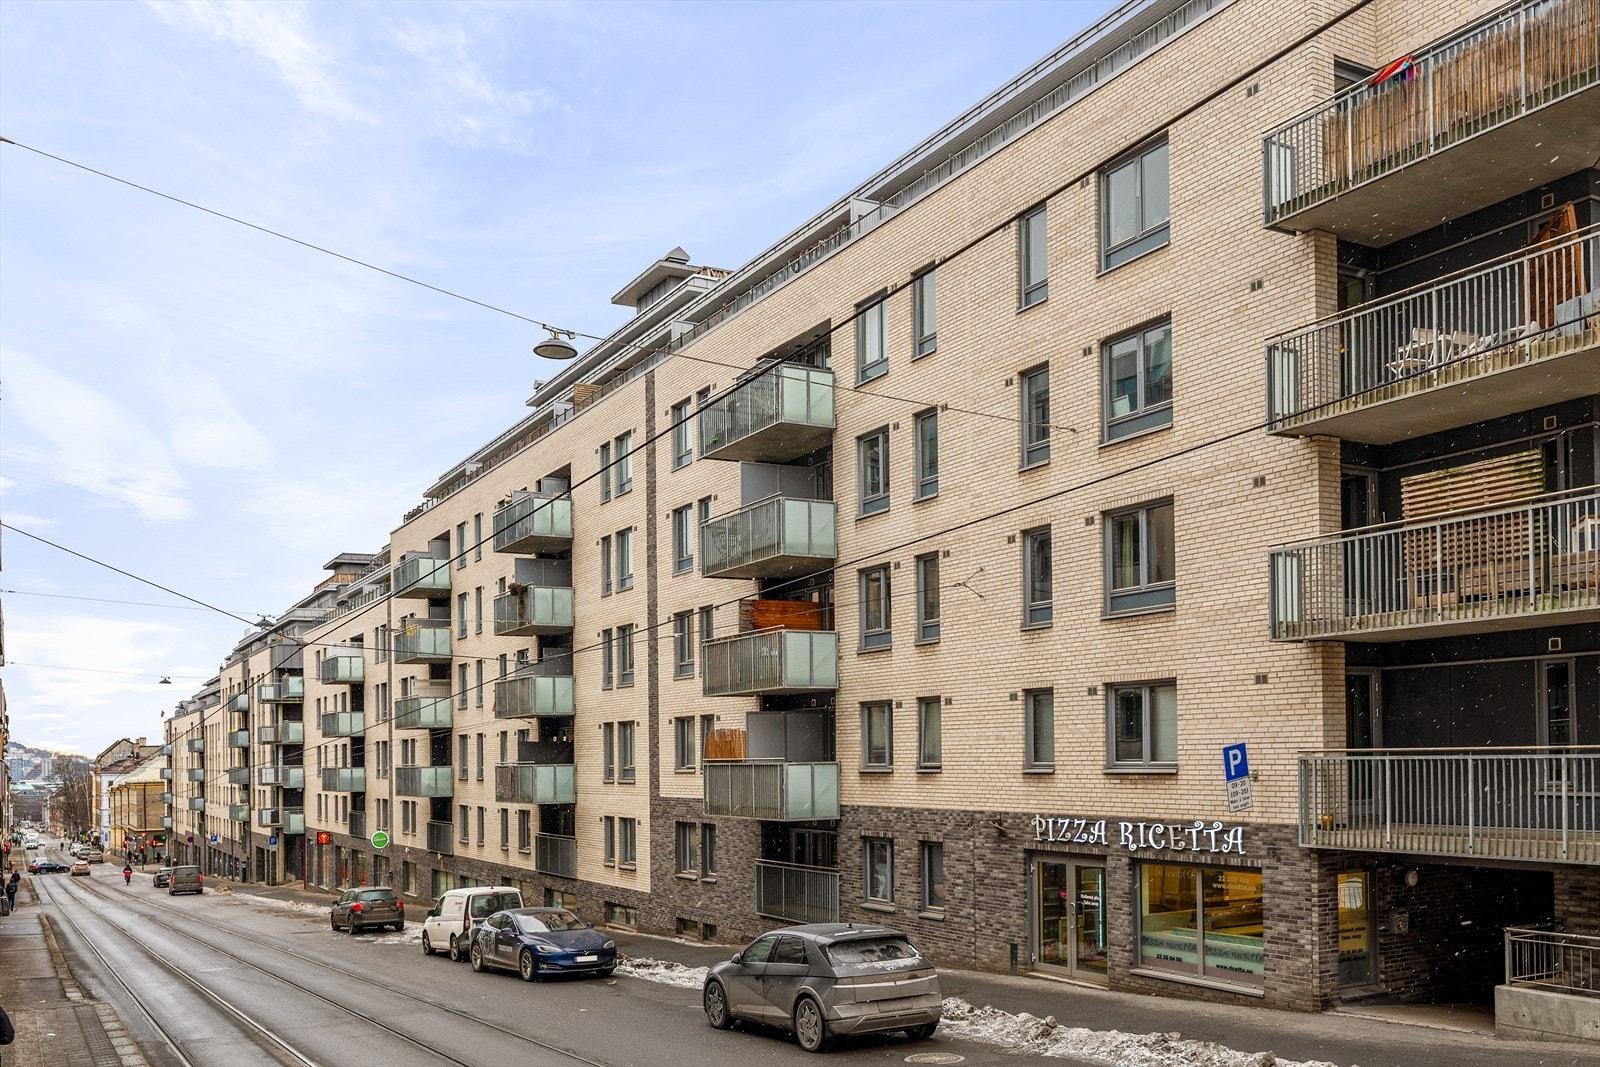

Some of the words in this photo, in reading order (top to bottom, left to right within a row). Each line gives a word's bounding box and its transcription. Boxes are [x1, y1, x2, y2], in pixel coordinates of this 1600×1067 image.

[1229, 749, 1241, 775] P
[1031, 814, 1108, 845] PIZZA
[1118, 820, 1246, 855] RICETTA
